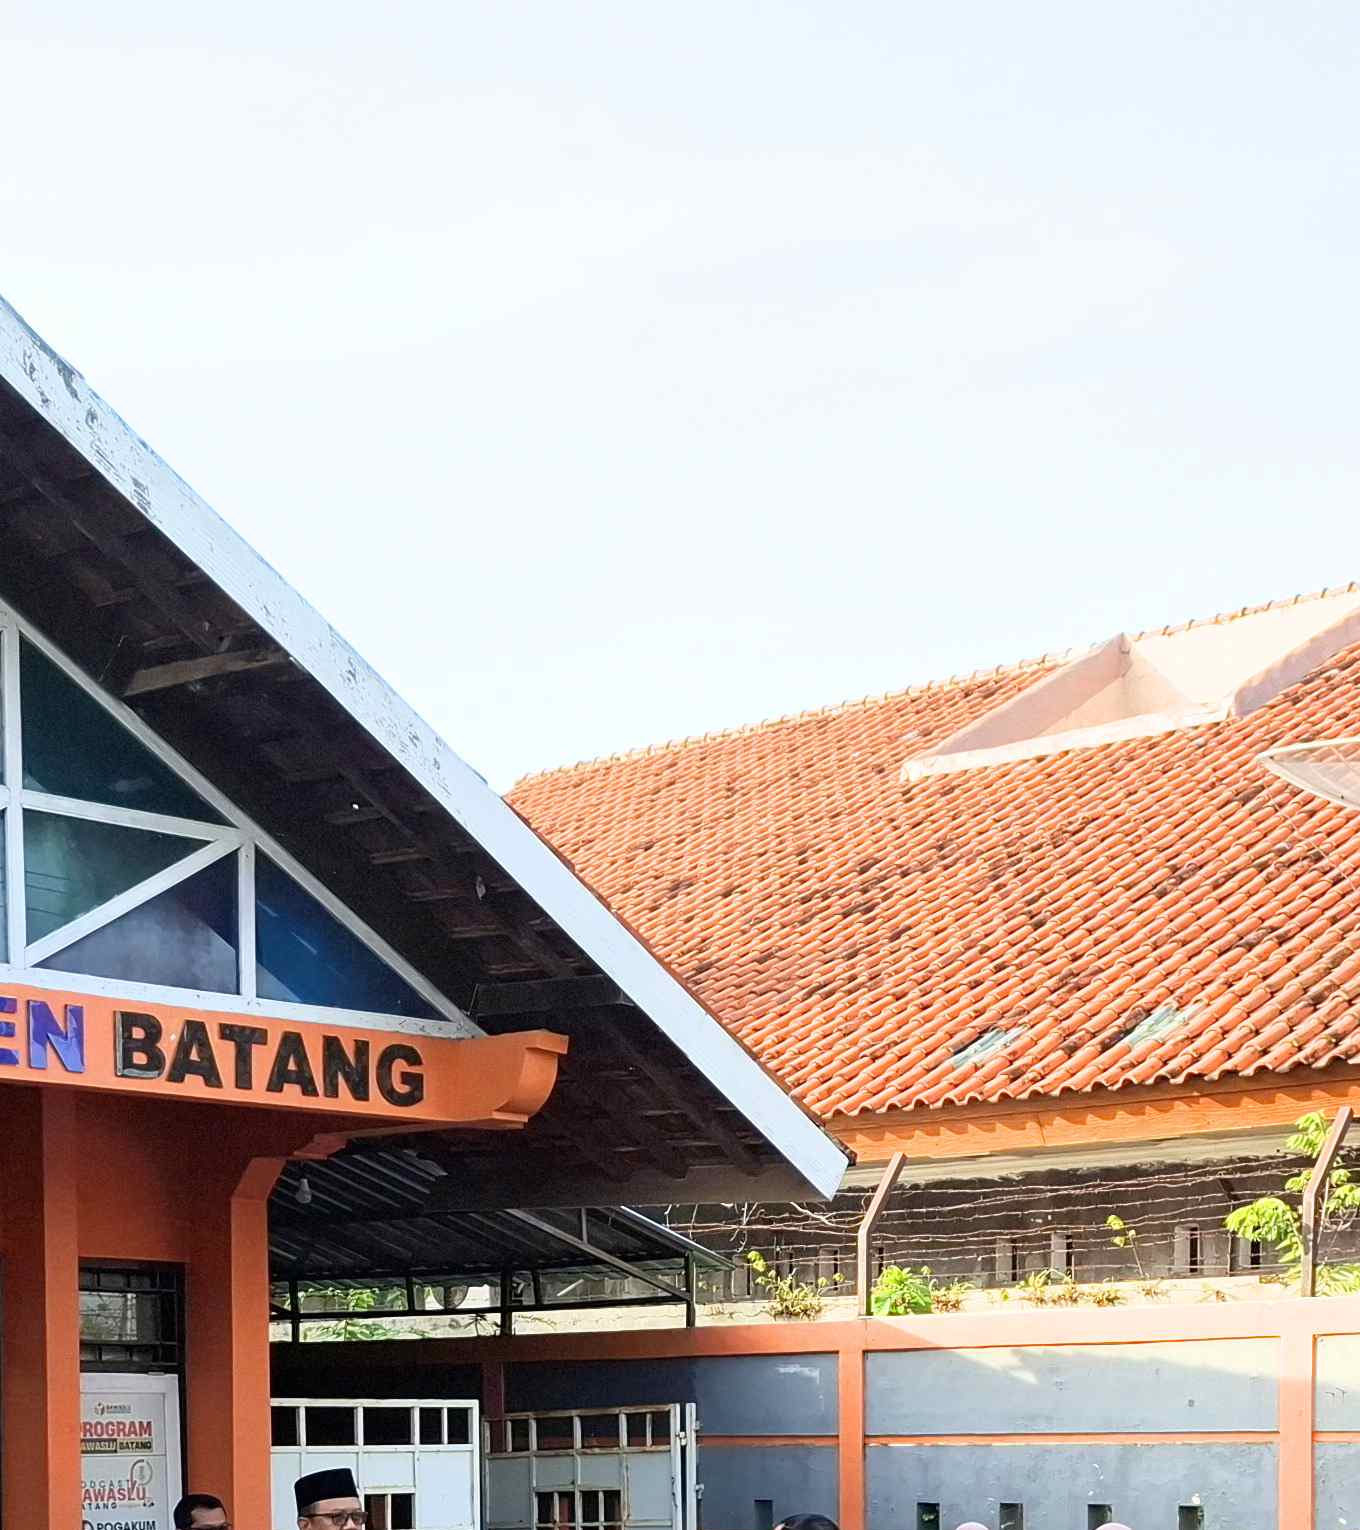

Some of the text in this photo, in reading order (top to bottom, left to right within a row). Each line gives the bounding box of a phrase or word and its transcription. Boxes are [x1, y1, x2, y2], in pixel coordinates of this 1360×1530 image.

[114, 1010, 427, 1109] BATANG
[81, 1420, 153, 1437] ROGRAM
[82, 1486, 146, 1502] AWASLU
